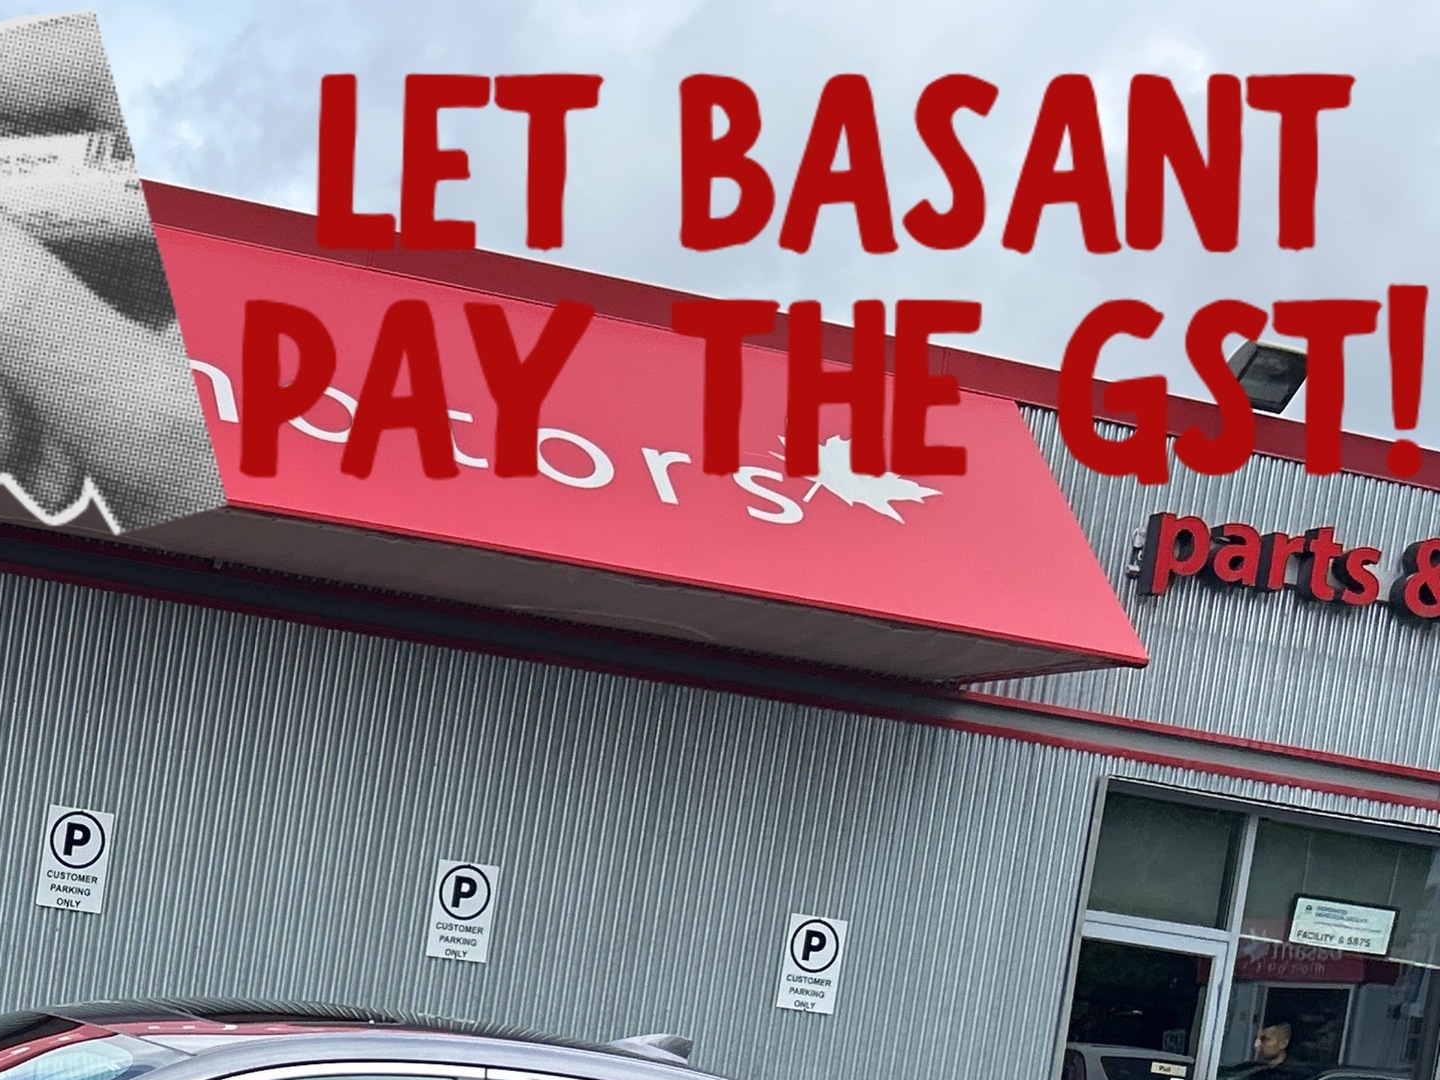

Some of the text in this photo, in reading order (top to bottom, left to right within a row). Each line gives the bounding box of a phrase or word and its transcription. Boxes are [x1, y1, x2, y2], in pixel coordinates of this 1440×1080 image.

[1145, 512, 1382, 606] parts
[63, 821, 92, 857] P
[46, 869, 98, 885] CUSTOMER
[50, 883, 91, 897] PARKING
[451, 875, 478, 909] P
[56, 897, 81, 908] ONLY
[435, 921, 484, 935] CUSTOMER
[438, 934, 478, 947] PARKING
[1297, 929, 1334, 943] FACILITY
[801, 929, 827, 962] P
[444, 948, 468, 958] ONLY
[786, 973, 832, 987] CUSTOMER
[788, 986, 825, 999] PARKING
[793, 1000, 816, 1010] ONLY
